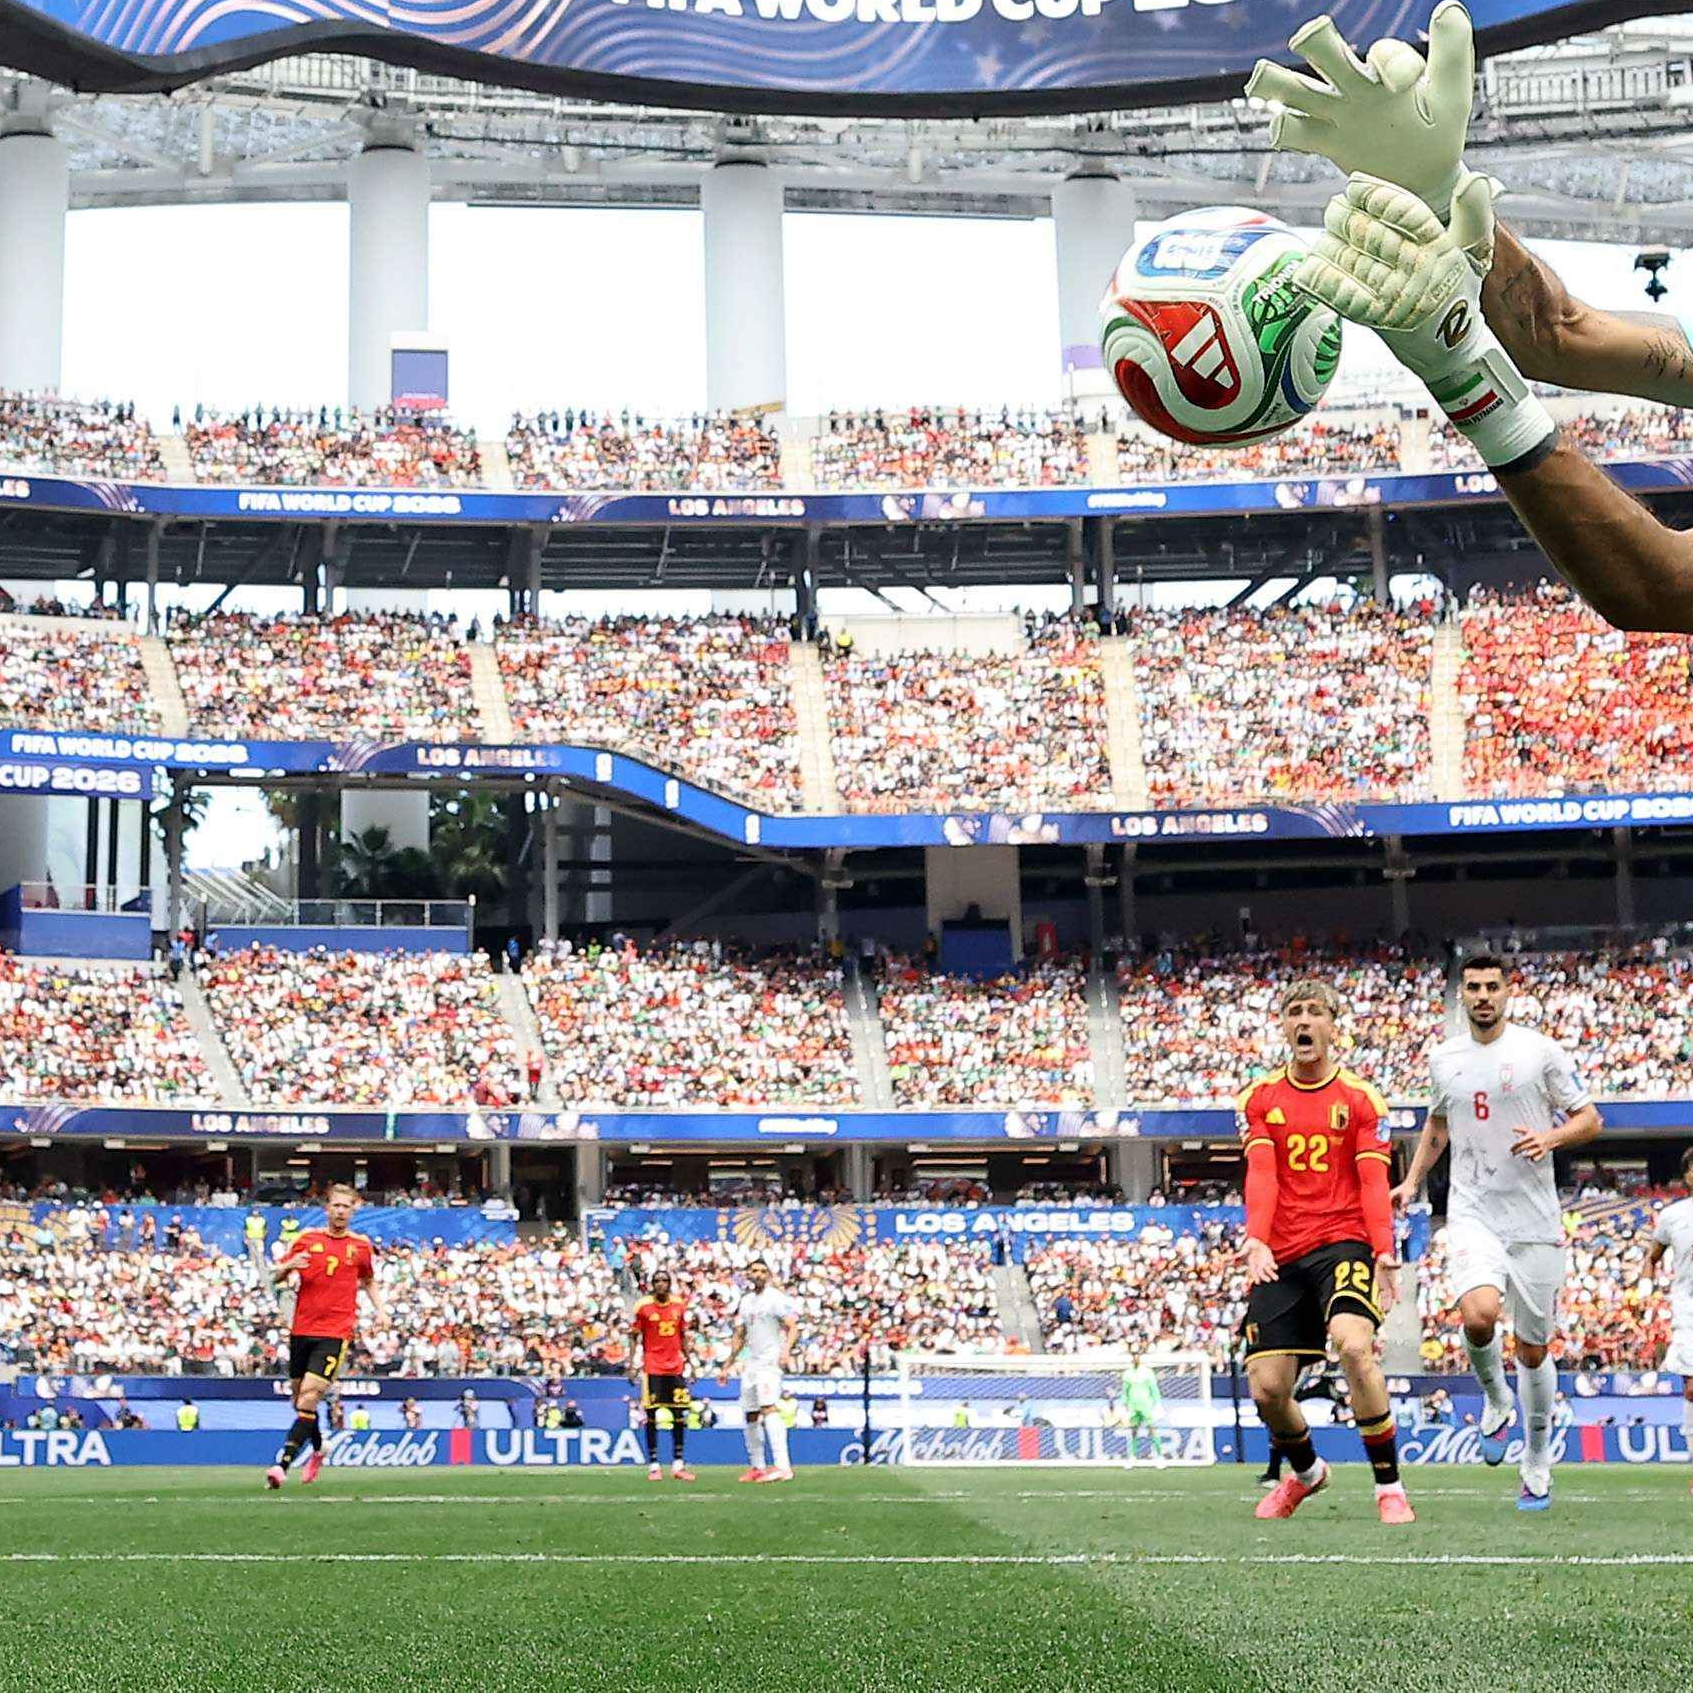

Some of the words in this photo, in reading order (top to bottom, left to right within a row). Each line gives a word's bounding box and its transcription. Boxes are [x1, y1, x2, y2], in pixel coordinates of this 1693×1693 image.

[668, 498, 709, 516] LOS
[49, 766, 142, 794] 2026
[1111, 815, 1157, 836] LOS
[1474, 1092, 1490, 1121] 6
[191, 1113, 232, 1133] LOS
[1287, 1134, 1329, 1171] 22
[896, 1213, 966, 1234] LOS
[971, 1211, 1135, 1233] ANGELES
[326, 1255, 339, 1276] 7
[324, 1356, 337, 1375] 7
[486, 1428, 646, 1465] ULTRA
